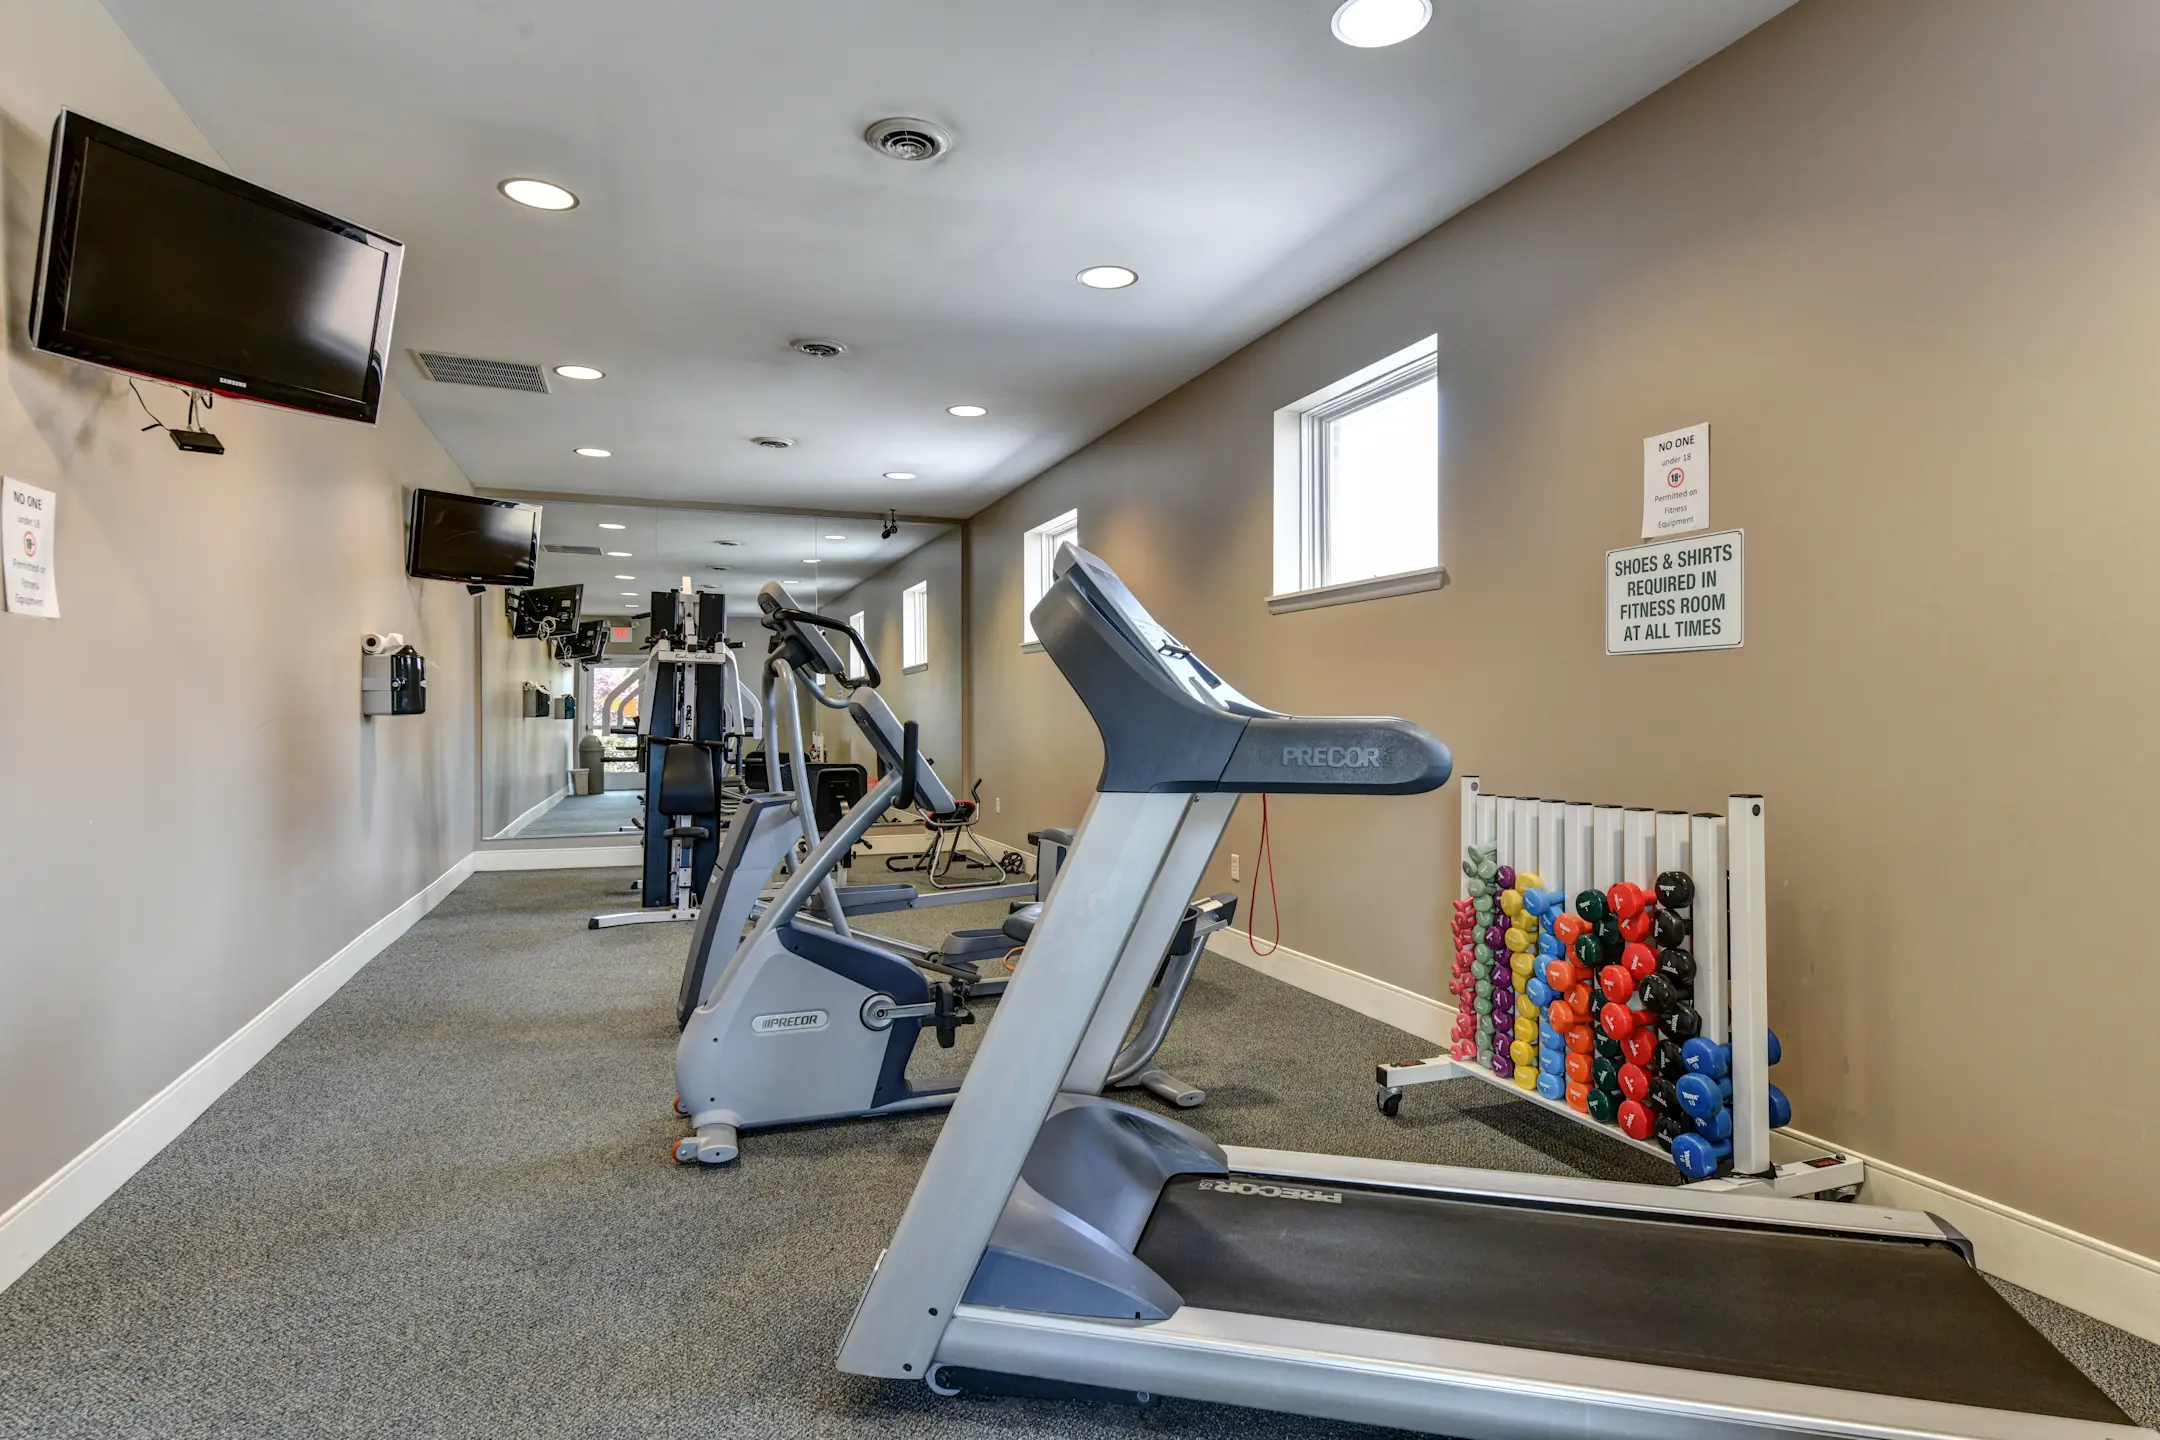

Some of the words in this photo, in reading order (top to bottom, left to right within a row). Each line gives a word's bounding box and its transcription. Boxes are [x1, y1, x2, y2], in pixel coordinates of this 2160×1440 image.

[219, 377, 247, 388] SAMSUNG
[1658, 440, 1673, 452] NO
[1675, 434, 1695, 450] ONE
[1661, 456, 1681, 467] under
[1683, 453, 1692, 462] 18
[13, 490, 25, 505] NO
[27, 495, 42, 511] ONE
[1654, 489, 1688, 503] Permitted
[1664, 505, 1688, 515] Fitness
[1658, 516, 1694, 529] Equipment
[1615, 555, 1658, 577] SHOES
[1662, 553, 1673, 570] &
[1677, 544, 1733, 568] SHIRTS
[1627, 573, 1696, 597] REQUIRED
[1702, 570, 1717, 588] IN
[1620, 599, 1675, 620] FITNESS
[1680, 593, 1726, 614] ROOM
[1623, 625, 1641, 642] AT
[1645, 623, 1670, 640] ALL
[1675, 618, 1721, 638] TIMES
[1282, 746, 1380, 768] PRECOR
[1661, 964, 1679, 975] YORK
[770, 1014, 818, 1028] PRECOR
[1671, 1014, 1679, 1033] YORK
[1681, 1090, 1700, 1101] YORK
[1683, 1150, 1692, 1170] YORK
[1214, 1180, 1342, 1204] PRECOR
